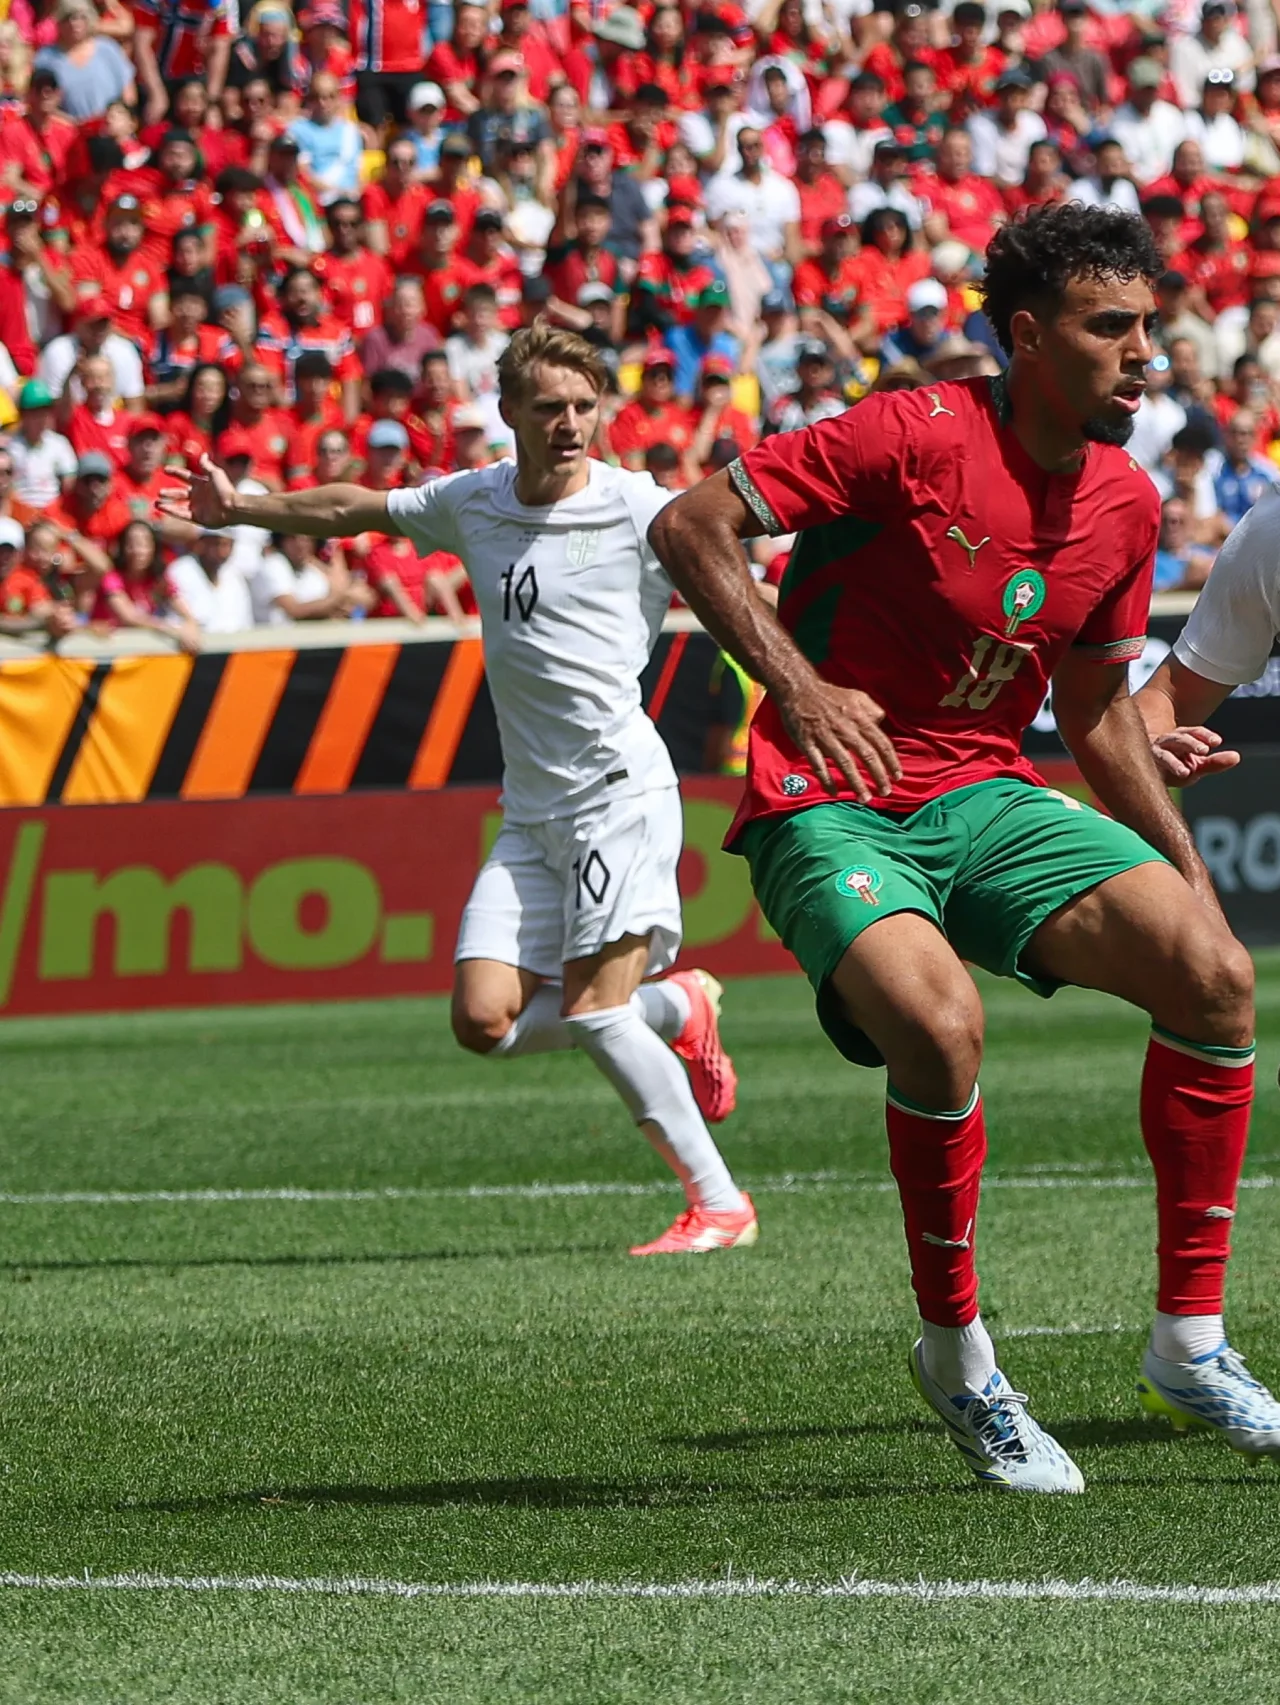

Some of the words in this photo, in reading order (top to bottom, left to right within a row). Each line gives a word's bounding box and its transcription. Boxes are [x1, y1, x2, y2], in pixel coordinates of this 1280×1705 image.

[501, 563, 539, 622] 10
[938, 634, 1034, 710] 18
[572, 849, 611, 910] 10
